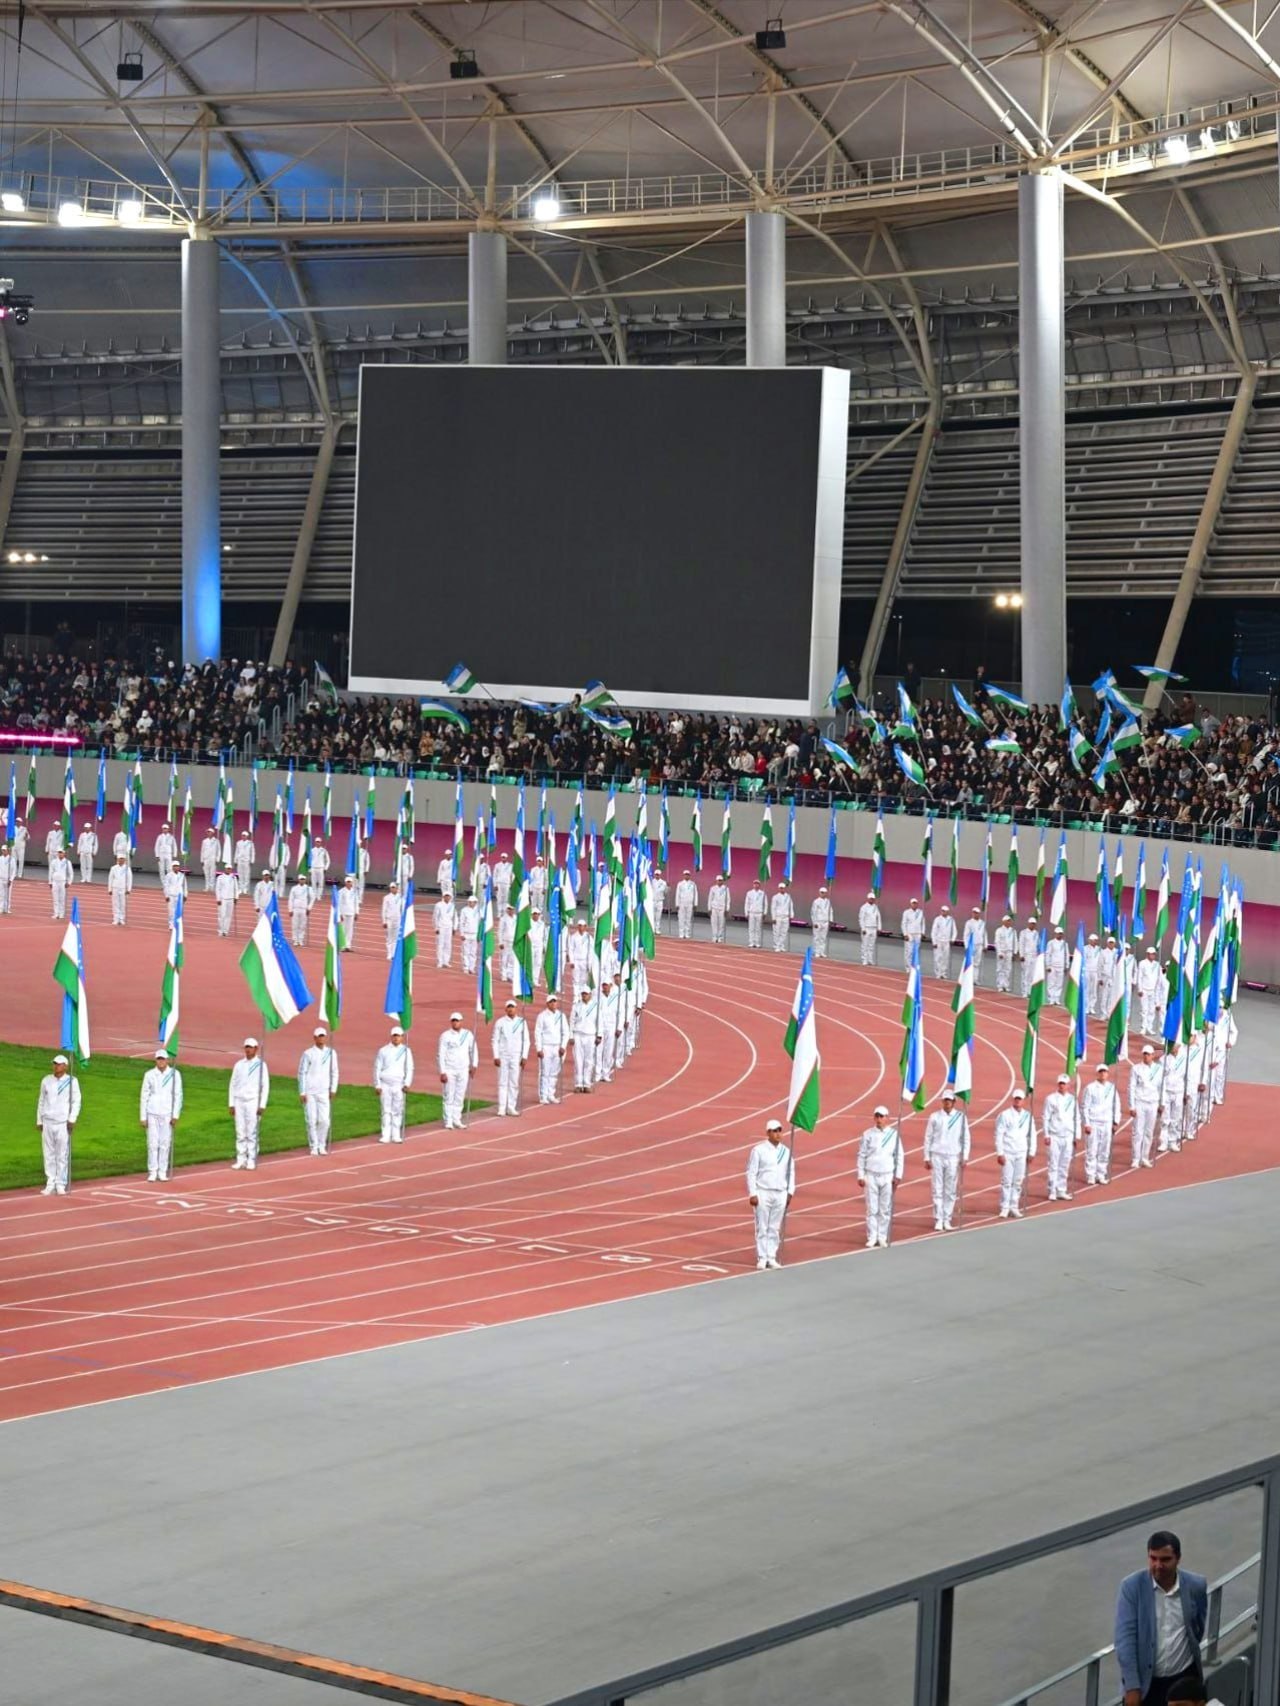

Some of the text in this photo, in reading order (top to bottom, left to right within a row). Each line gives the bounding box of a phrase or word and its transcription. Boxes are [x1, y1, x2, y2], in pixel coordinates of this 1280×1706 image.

[156, 1200, 207, 1209] 2
[227, 1208, 275, 1216] 3
[304, 1217, 349, 1225] 4
[368, 1226, 419, 1235] 5
[452, 1235, 496, 1244] 6
[519, 1244, 569, 1253] 7
[600, 1254, 652, 1264] 8
[682, 1264, 729, 1274] 9
